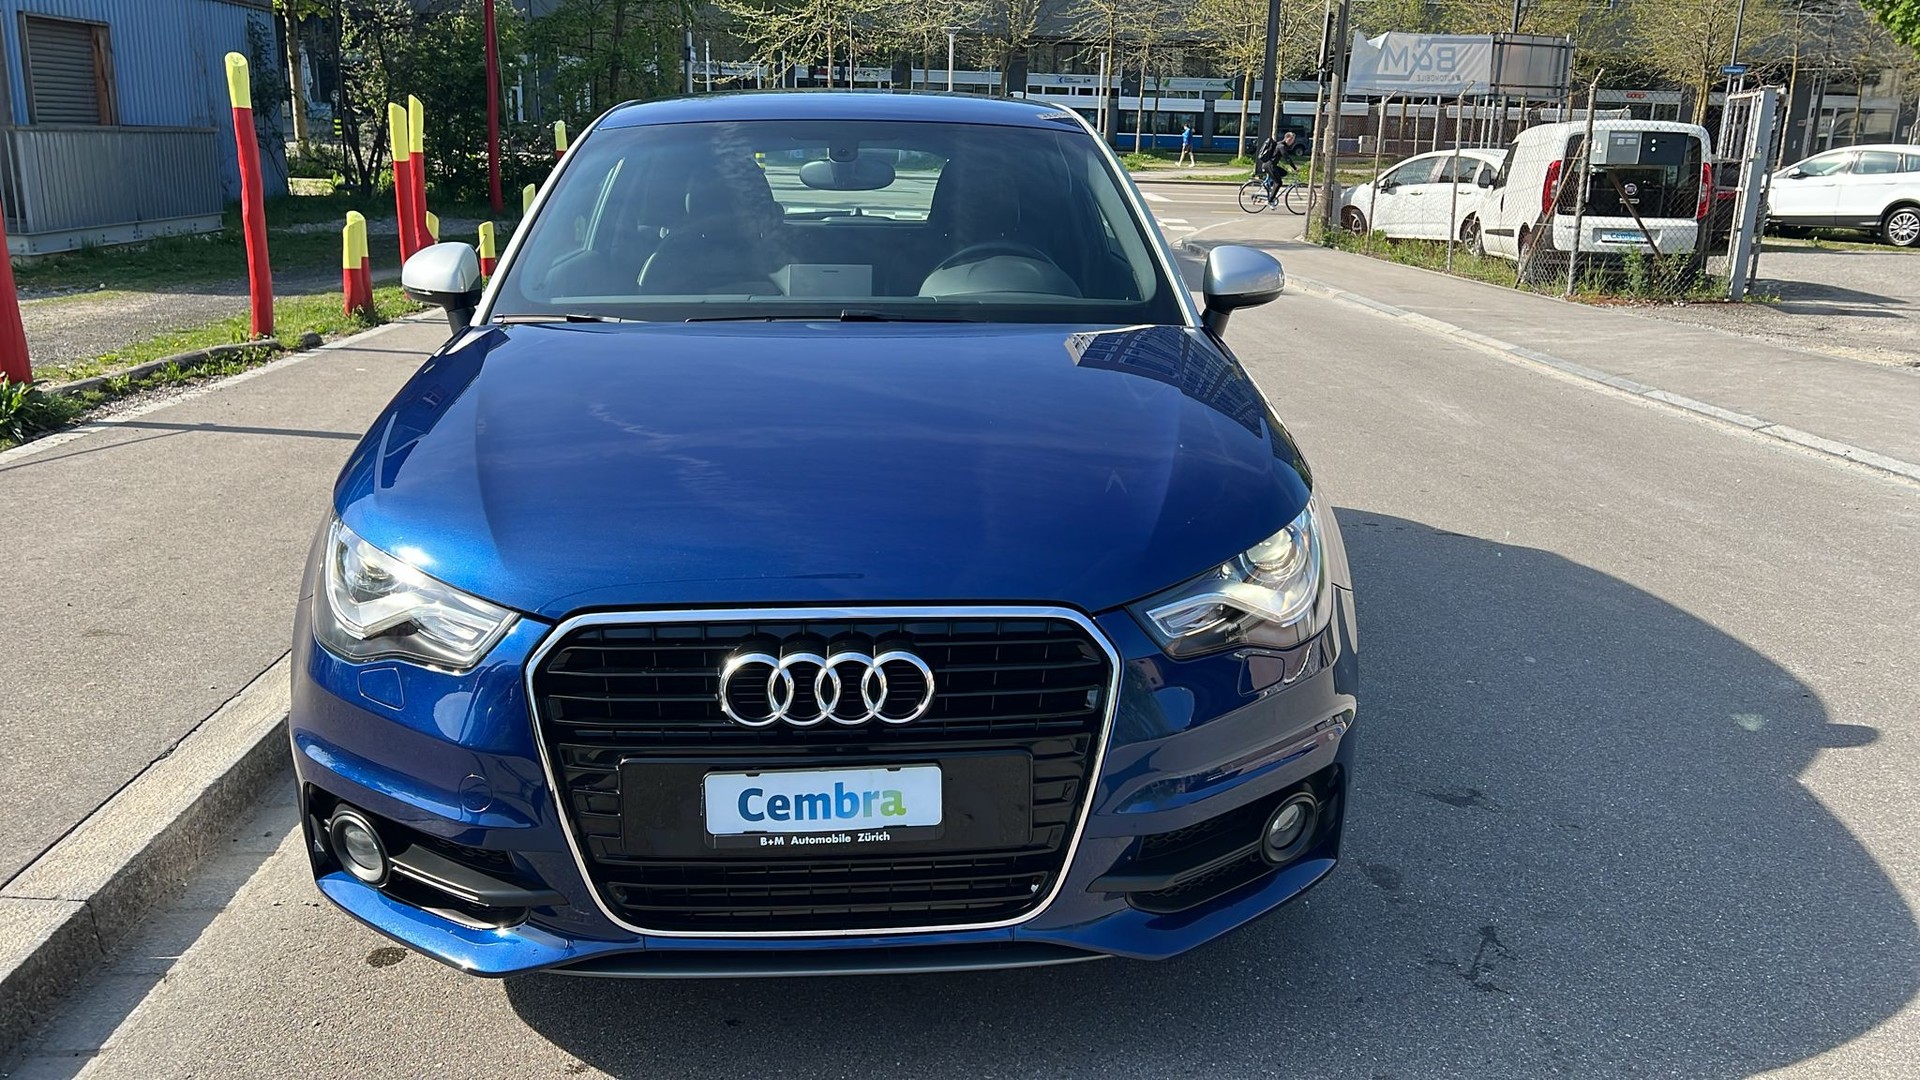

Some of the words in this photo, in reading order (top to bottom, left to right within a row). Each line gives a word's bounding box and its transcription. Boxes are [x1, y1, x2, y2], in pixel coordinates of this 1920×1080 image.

[737, 782, 907, 822] Cembra
[760, 836, 785, 846] B+M
[790, 833, 852, 846] Automobile
[857, 831, 890, 843] Zürich
